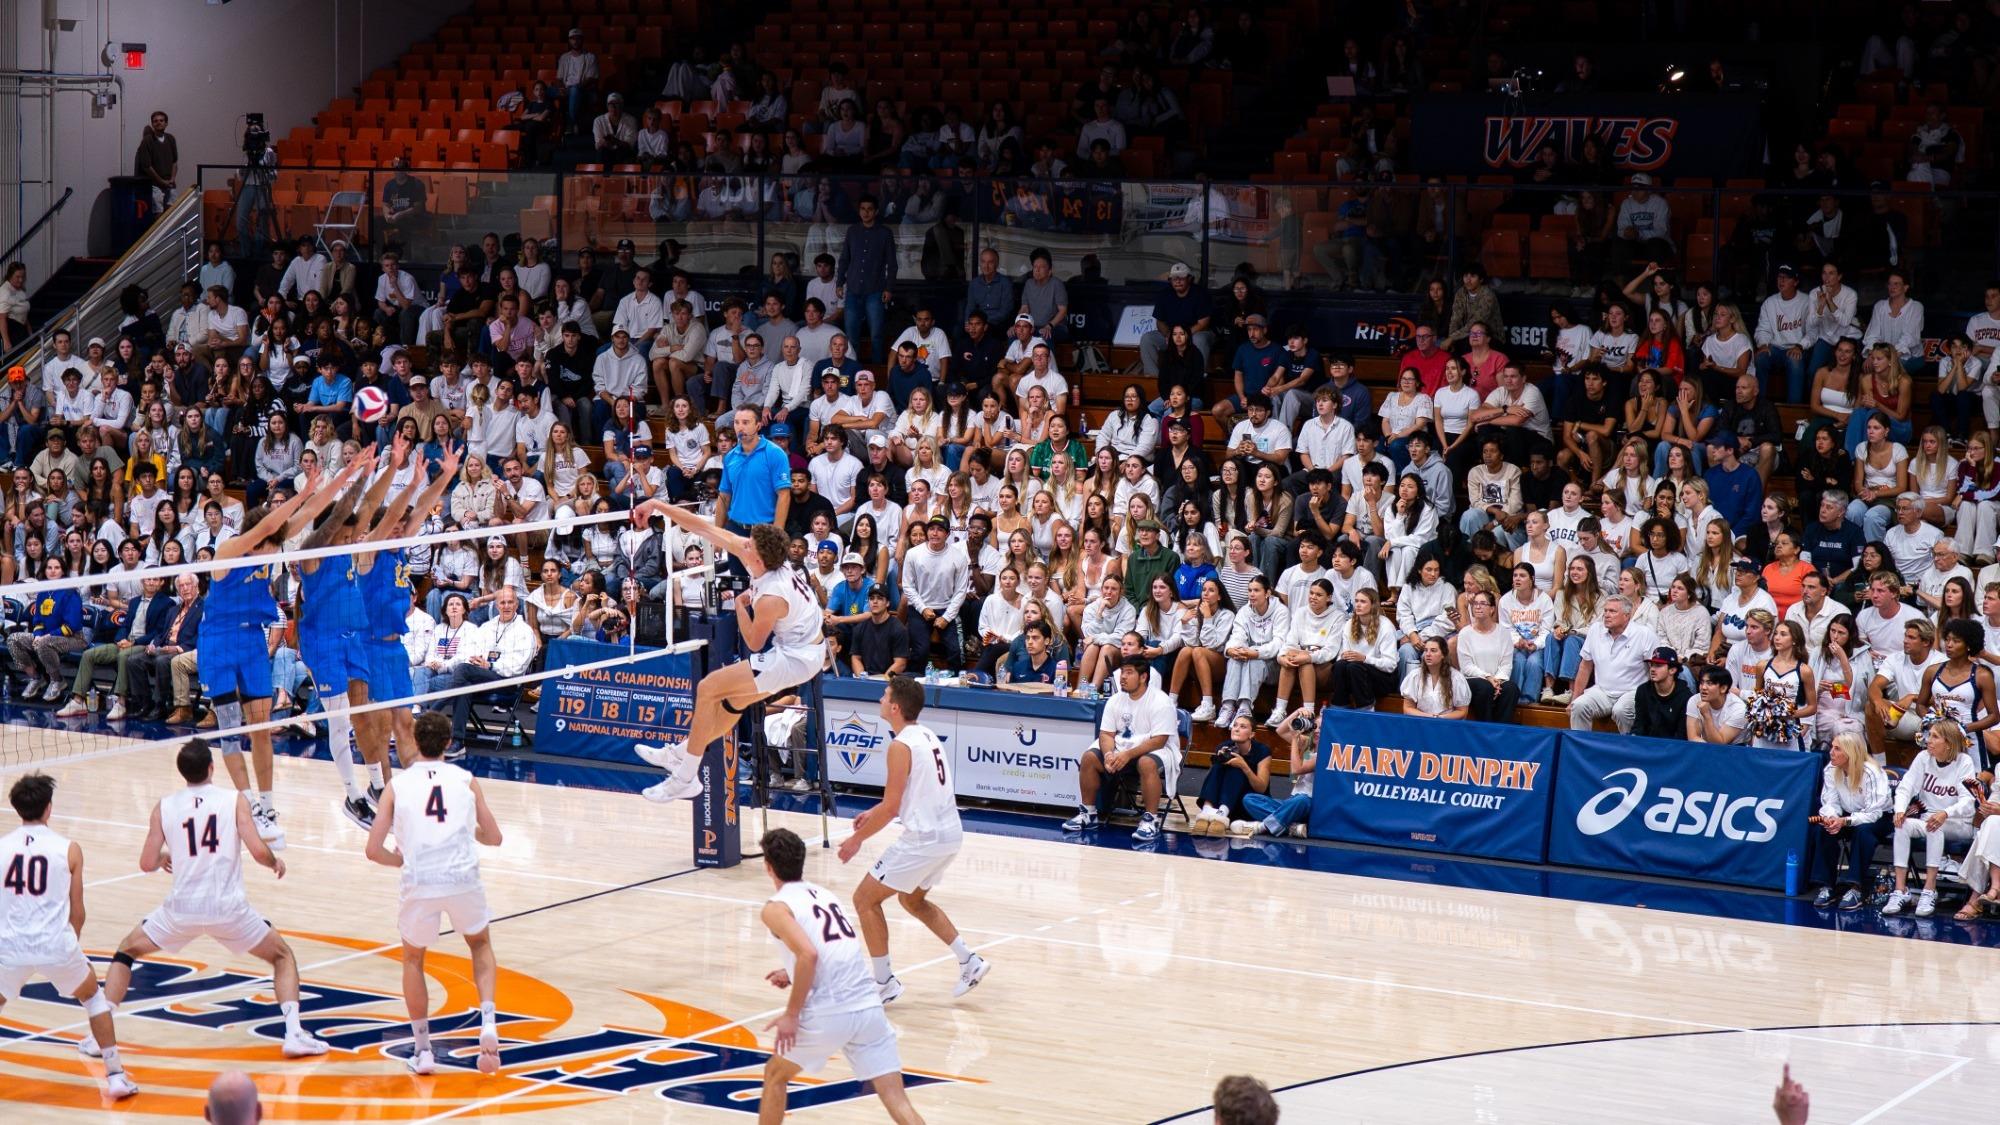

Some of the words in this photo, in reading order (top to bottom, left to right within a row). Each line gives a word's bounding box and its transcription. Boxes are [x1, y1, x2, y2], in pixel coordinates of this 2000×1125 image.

[1484, 117, 1680, 171] WAVES
[1067, 313, 1086, 328] rg
[579, 669, 611, 682] NCAA
[596, 688, 629, 699] CONFERENCE
[632, 693, 666, 703] OLYMPIANS
[559, 696, 586, 715] 119
[601, 701, 620, 719] 18
[638, 705, 656, 722] 15
[674, 709, 693, 727] 17
[555, 719, 566, 732] 9
[569, 722, 611, 734] NATIONAL
[612, 725, 644, 739] PLAYERS
[644, 731, 657, 740] OF
[658, 732, 673, 742] THE
[825, 732, 884, 748] MPSF
[932, 747, 947, 787] 5
[967, 746, 1081, 772] UNIVERSITY
[1325, 742, 1415, 779] MARV
[1417, 751, 1542, 791] DUNPHY
[703, 766, 712, 793] sports
[976, 783, 992, 791] Bank
[992, 784, 1006, 792] with
[1006, 787, 1020, 796] your
[194, 797, 203, 809] P
[425, 785, 447, 824] 4
[1054, 793, 1077, 802] ucu.org
[1354, 781, 1447, 805] VOLLEYBALL
[1450, 791, 1505, 810] COURT
[703, 793, 713, 826] imports
[1644, 787, 1785, 843] asics
[25, 835, 35, 847] P
[182, 813, 220, 857] 14
[702, 829, 717, 849] P
[4, 853, 49, 896] 40
[812, 902, 857, 944] 26
